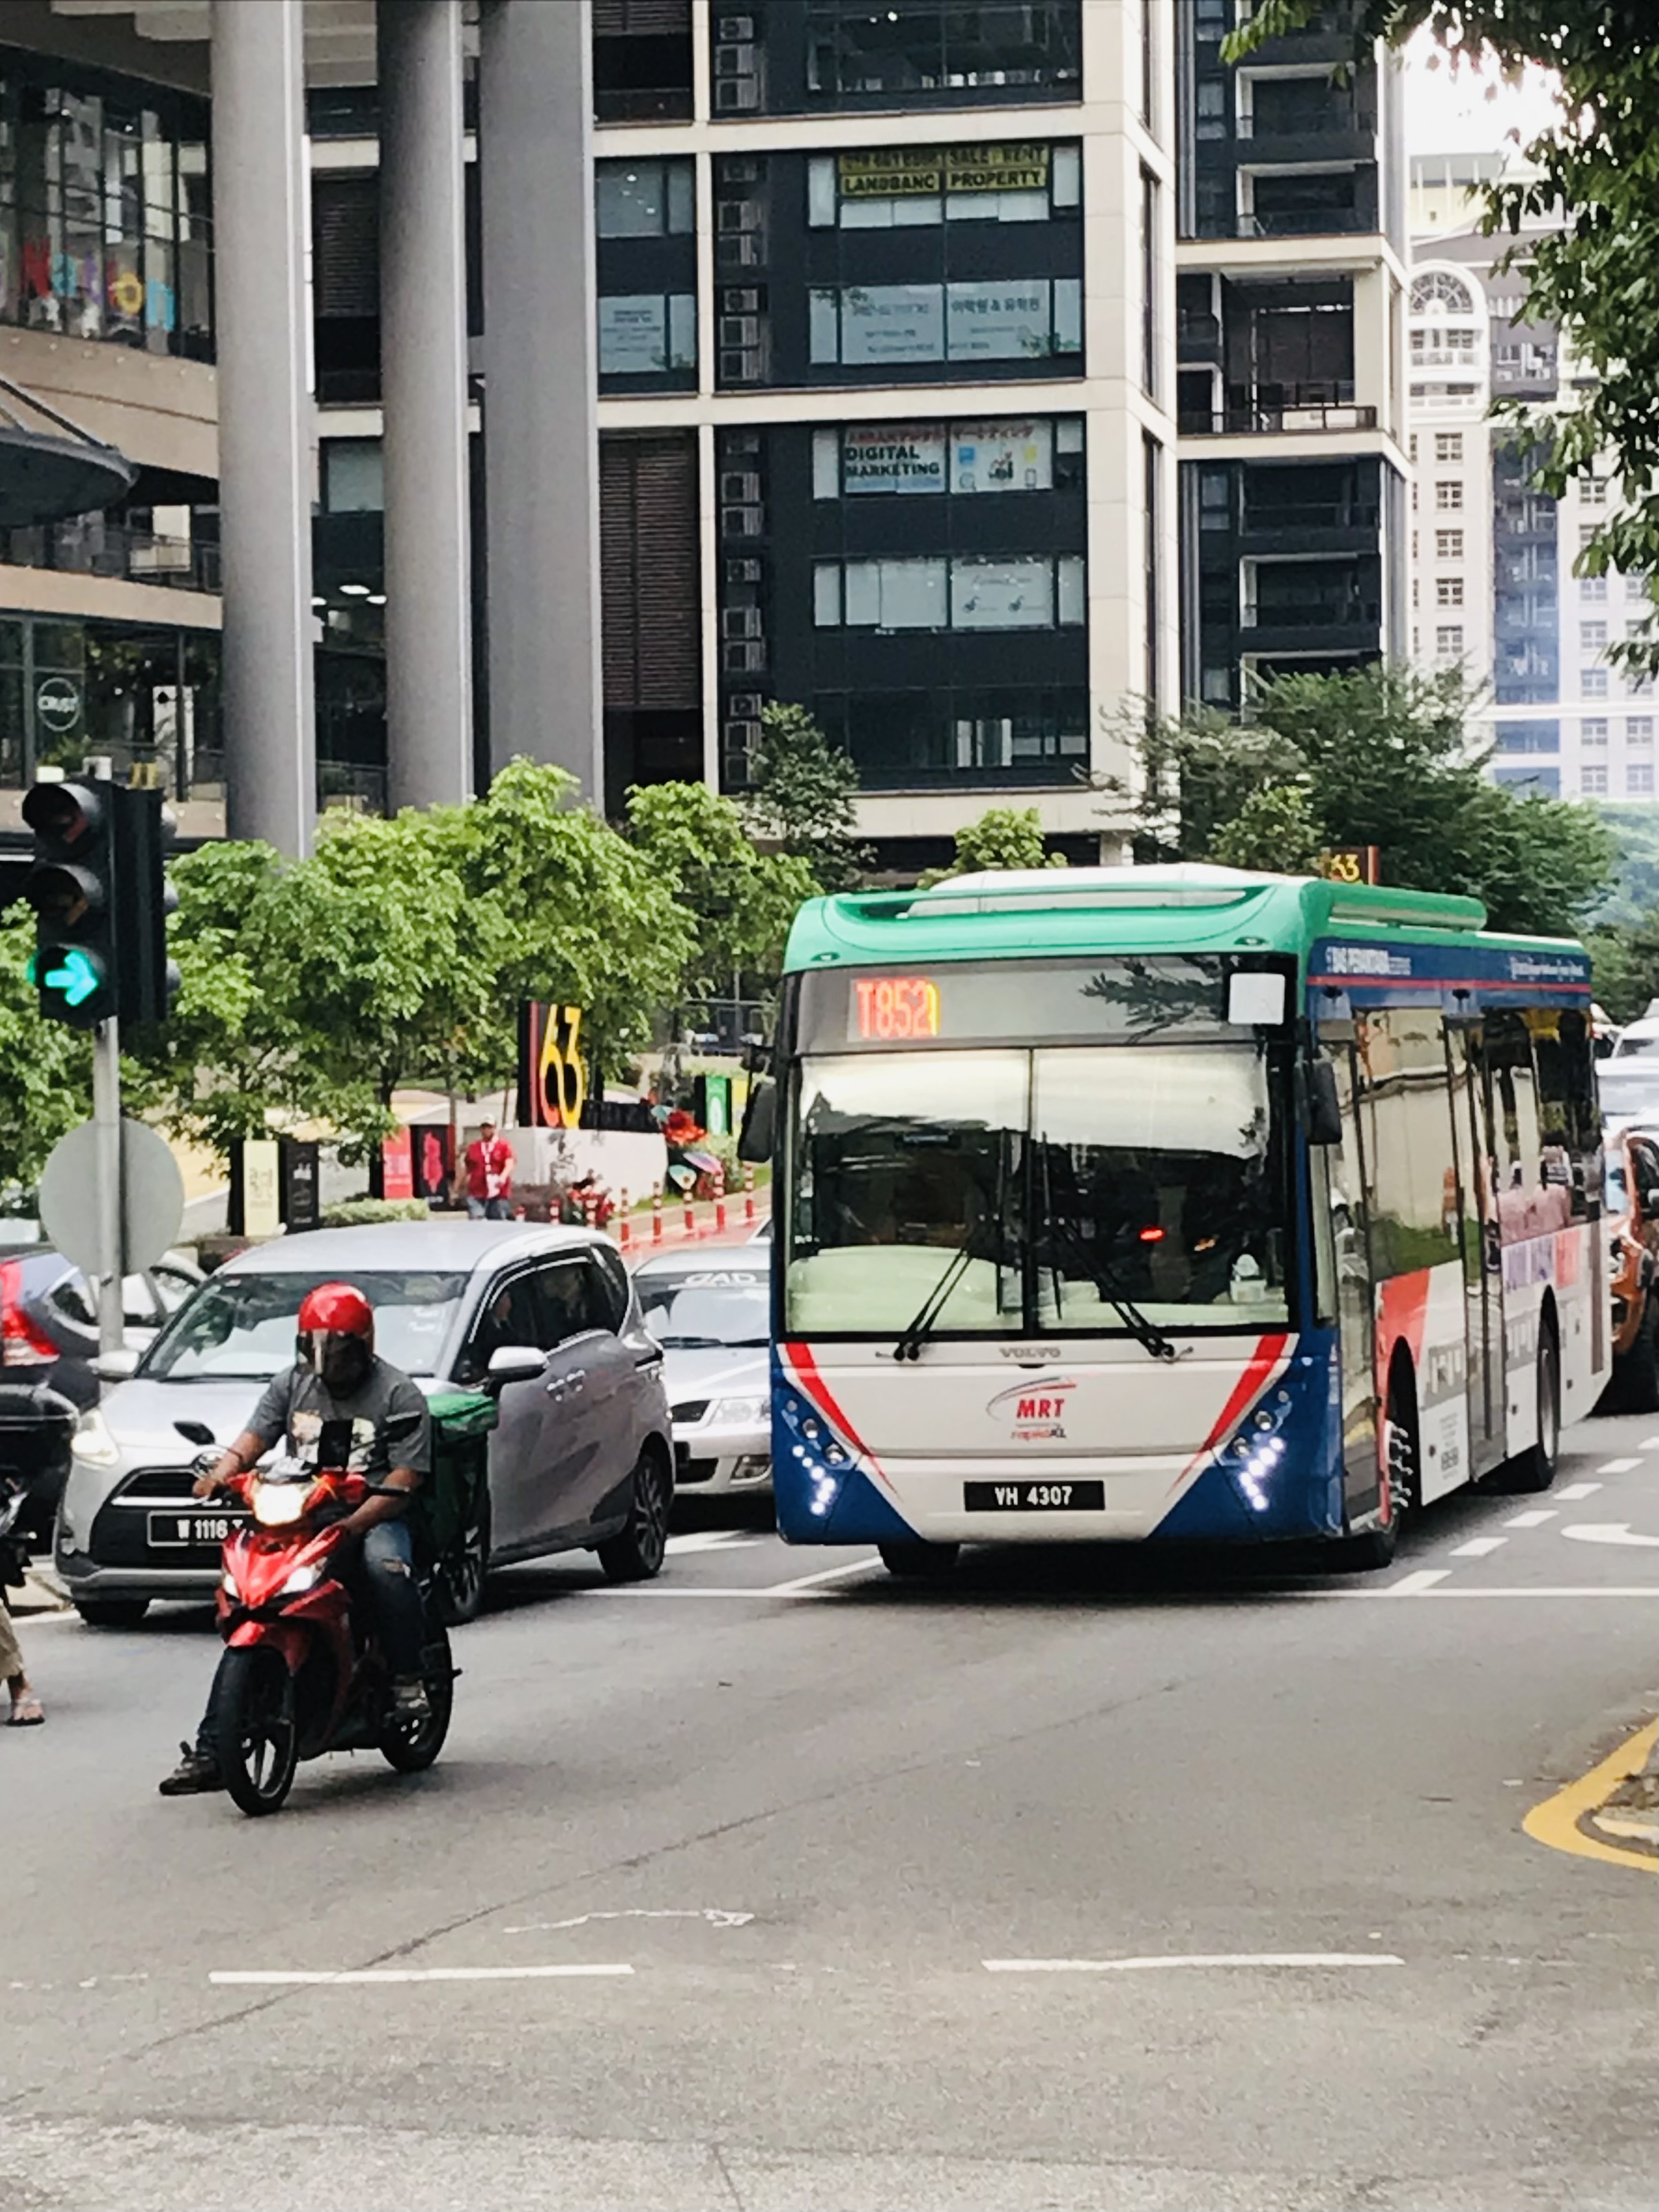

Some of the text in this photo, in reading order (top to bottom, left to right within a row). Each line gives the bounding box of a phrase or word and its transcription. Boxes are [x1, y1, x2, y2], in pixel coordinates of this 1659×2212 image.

[951, 170, 1041, 187] PROPERTY
[845, 445, 920, 460] DIGITAL
[845, 463, 939, 477] MARKETING
[856, 978, 932, 1037] T852
[539, 1003, 582, 1129] 63
[1000, 1347, 1061, 1359] VOLVO
[1017, 1399, 1065, 1419] MRT
[995, 1485, 1072, 1506] VH 4307
[194, 1519, 228, 1539] 1116
